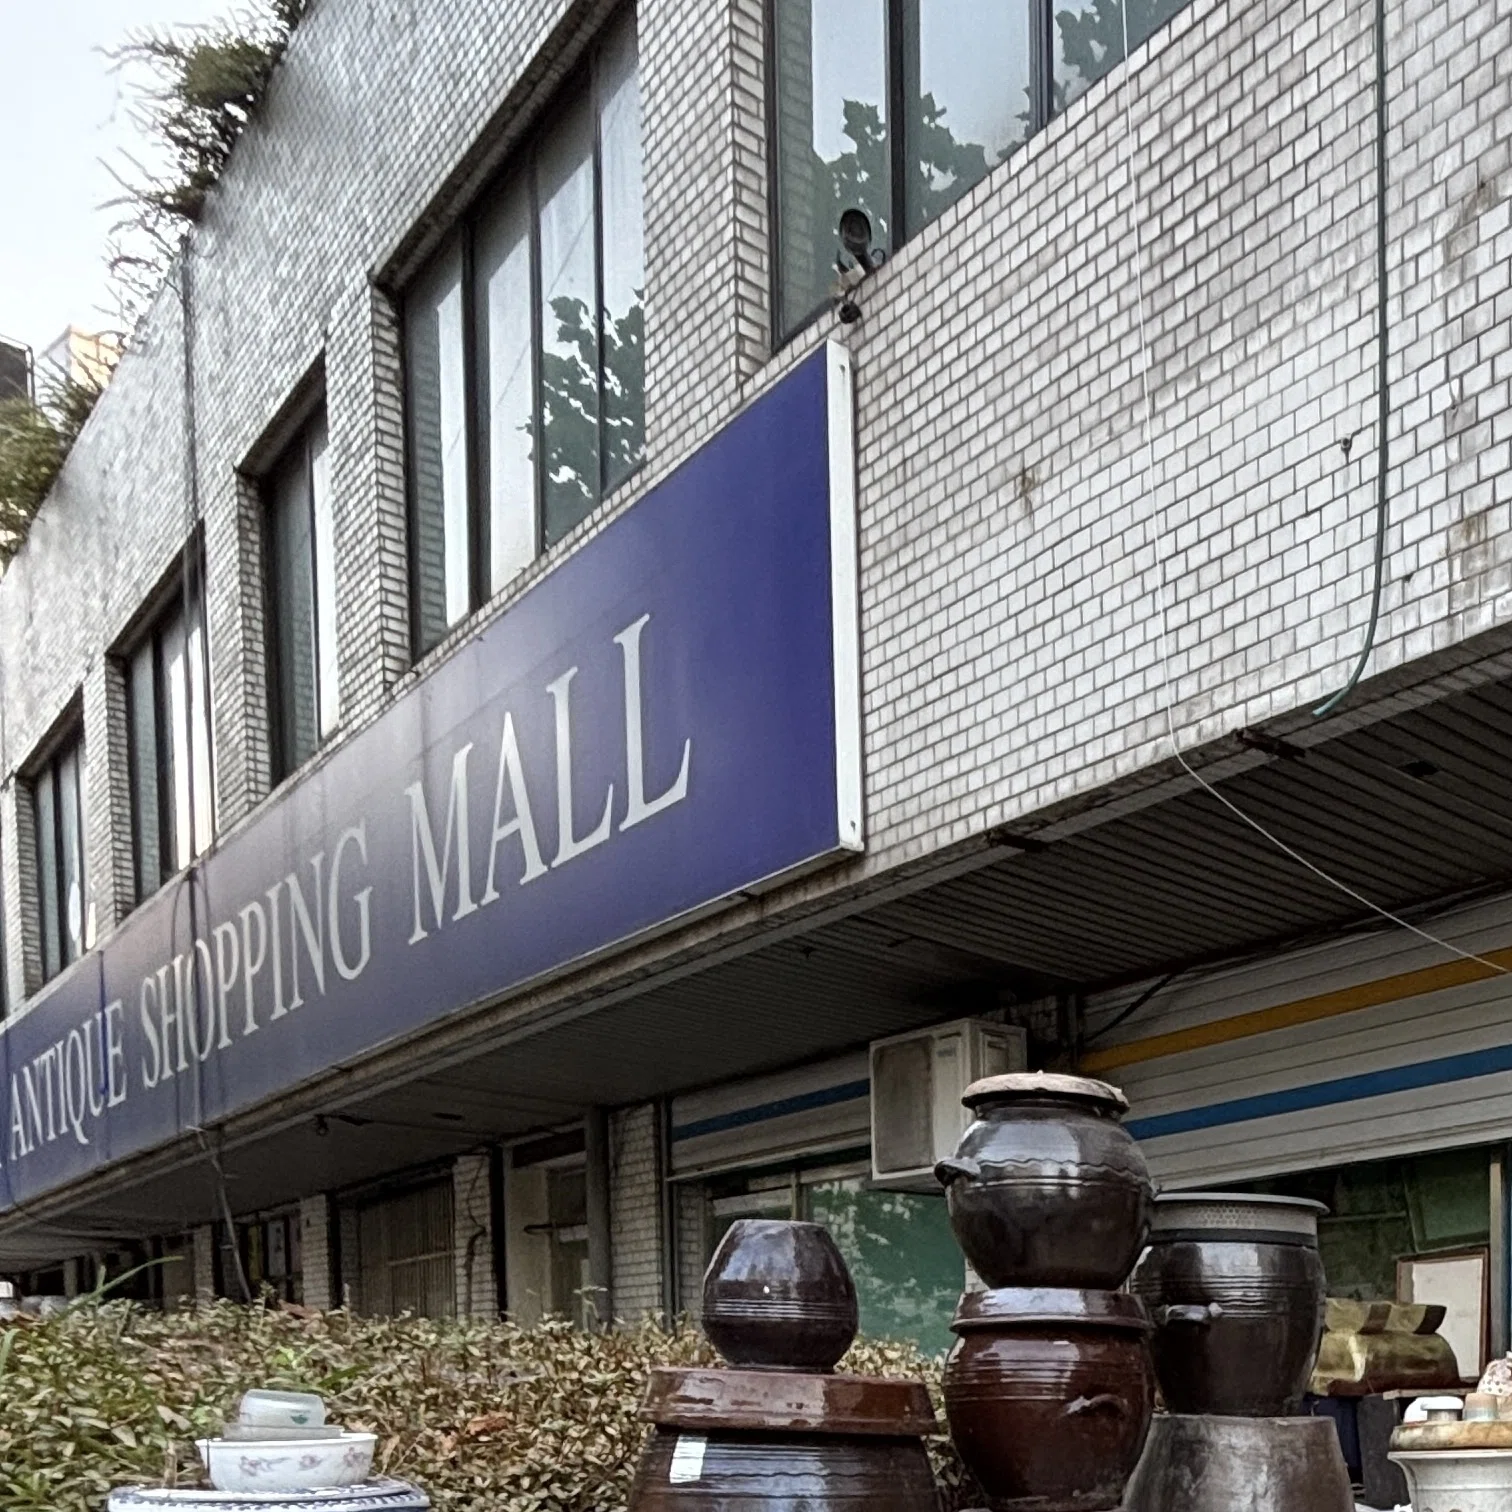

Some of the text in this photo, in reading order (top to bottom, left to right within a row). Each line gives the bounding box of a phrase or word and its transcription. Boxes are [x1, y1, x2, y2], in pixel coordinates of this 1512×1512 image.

[10, 612, 691, 1161] ANTIQUE SHOPPING MALL
